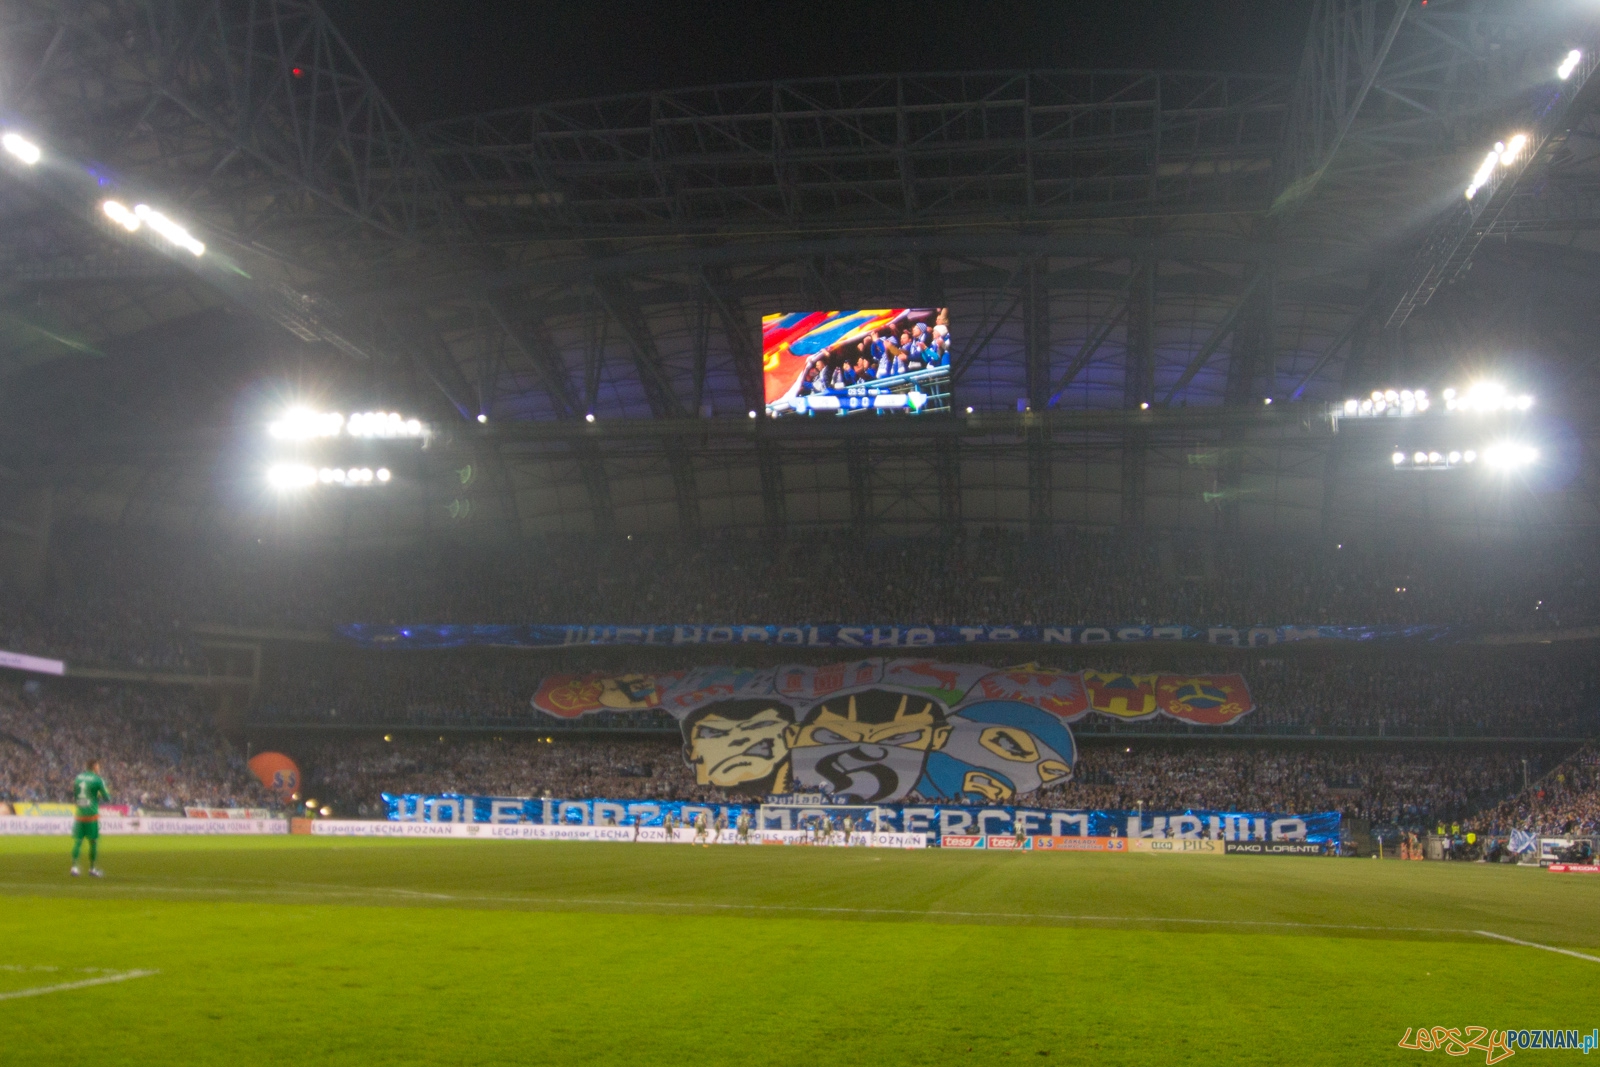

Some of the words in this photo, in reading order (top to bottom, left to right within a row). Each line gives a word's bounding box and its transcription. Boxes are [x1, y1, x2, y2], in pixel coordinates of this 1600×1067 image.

[945, 836, 972, 847] tesa
[1182, 840, 1215, 851] PILS
[1227, 844, 1261, 852] PAKO
